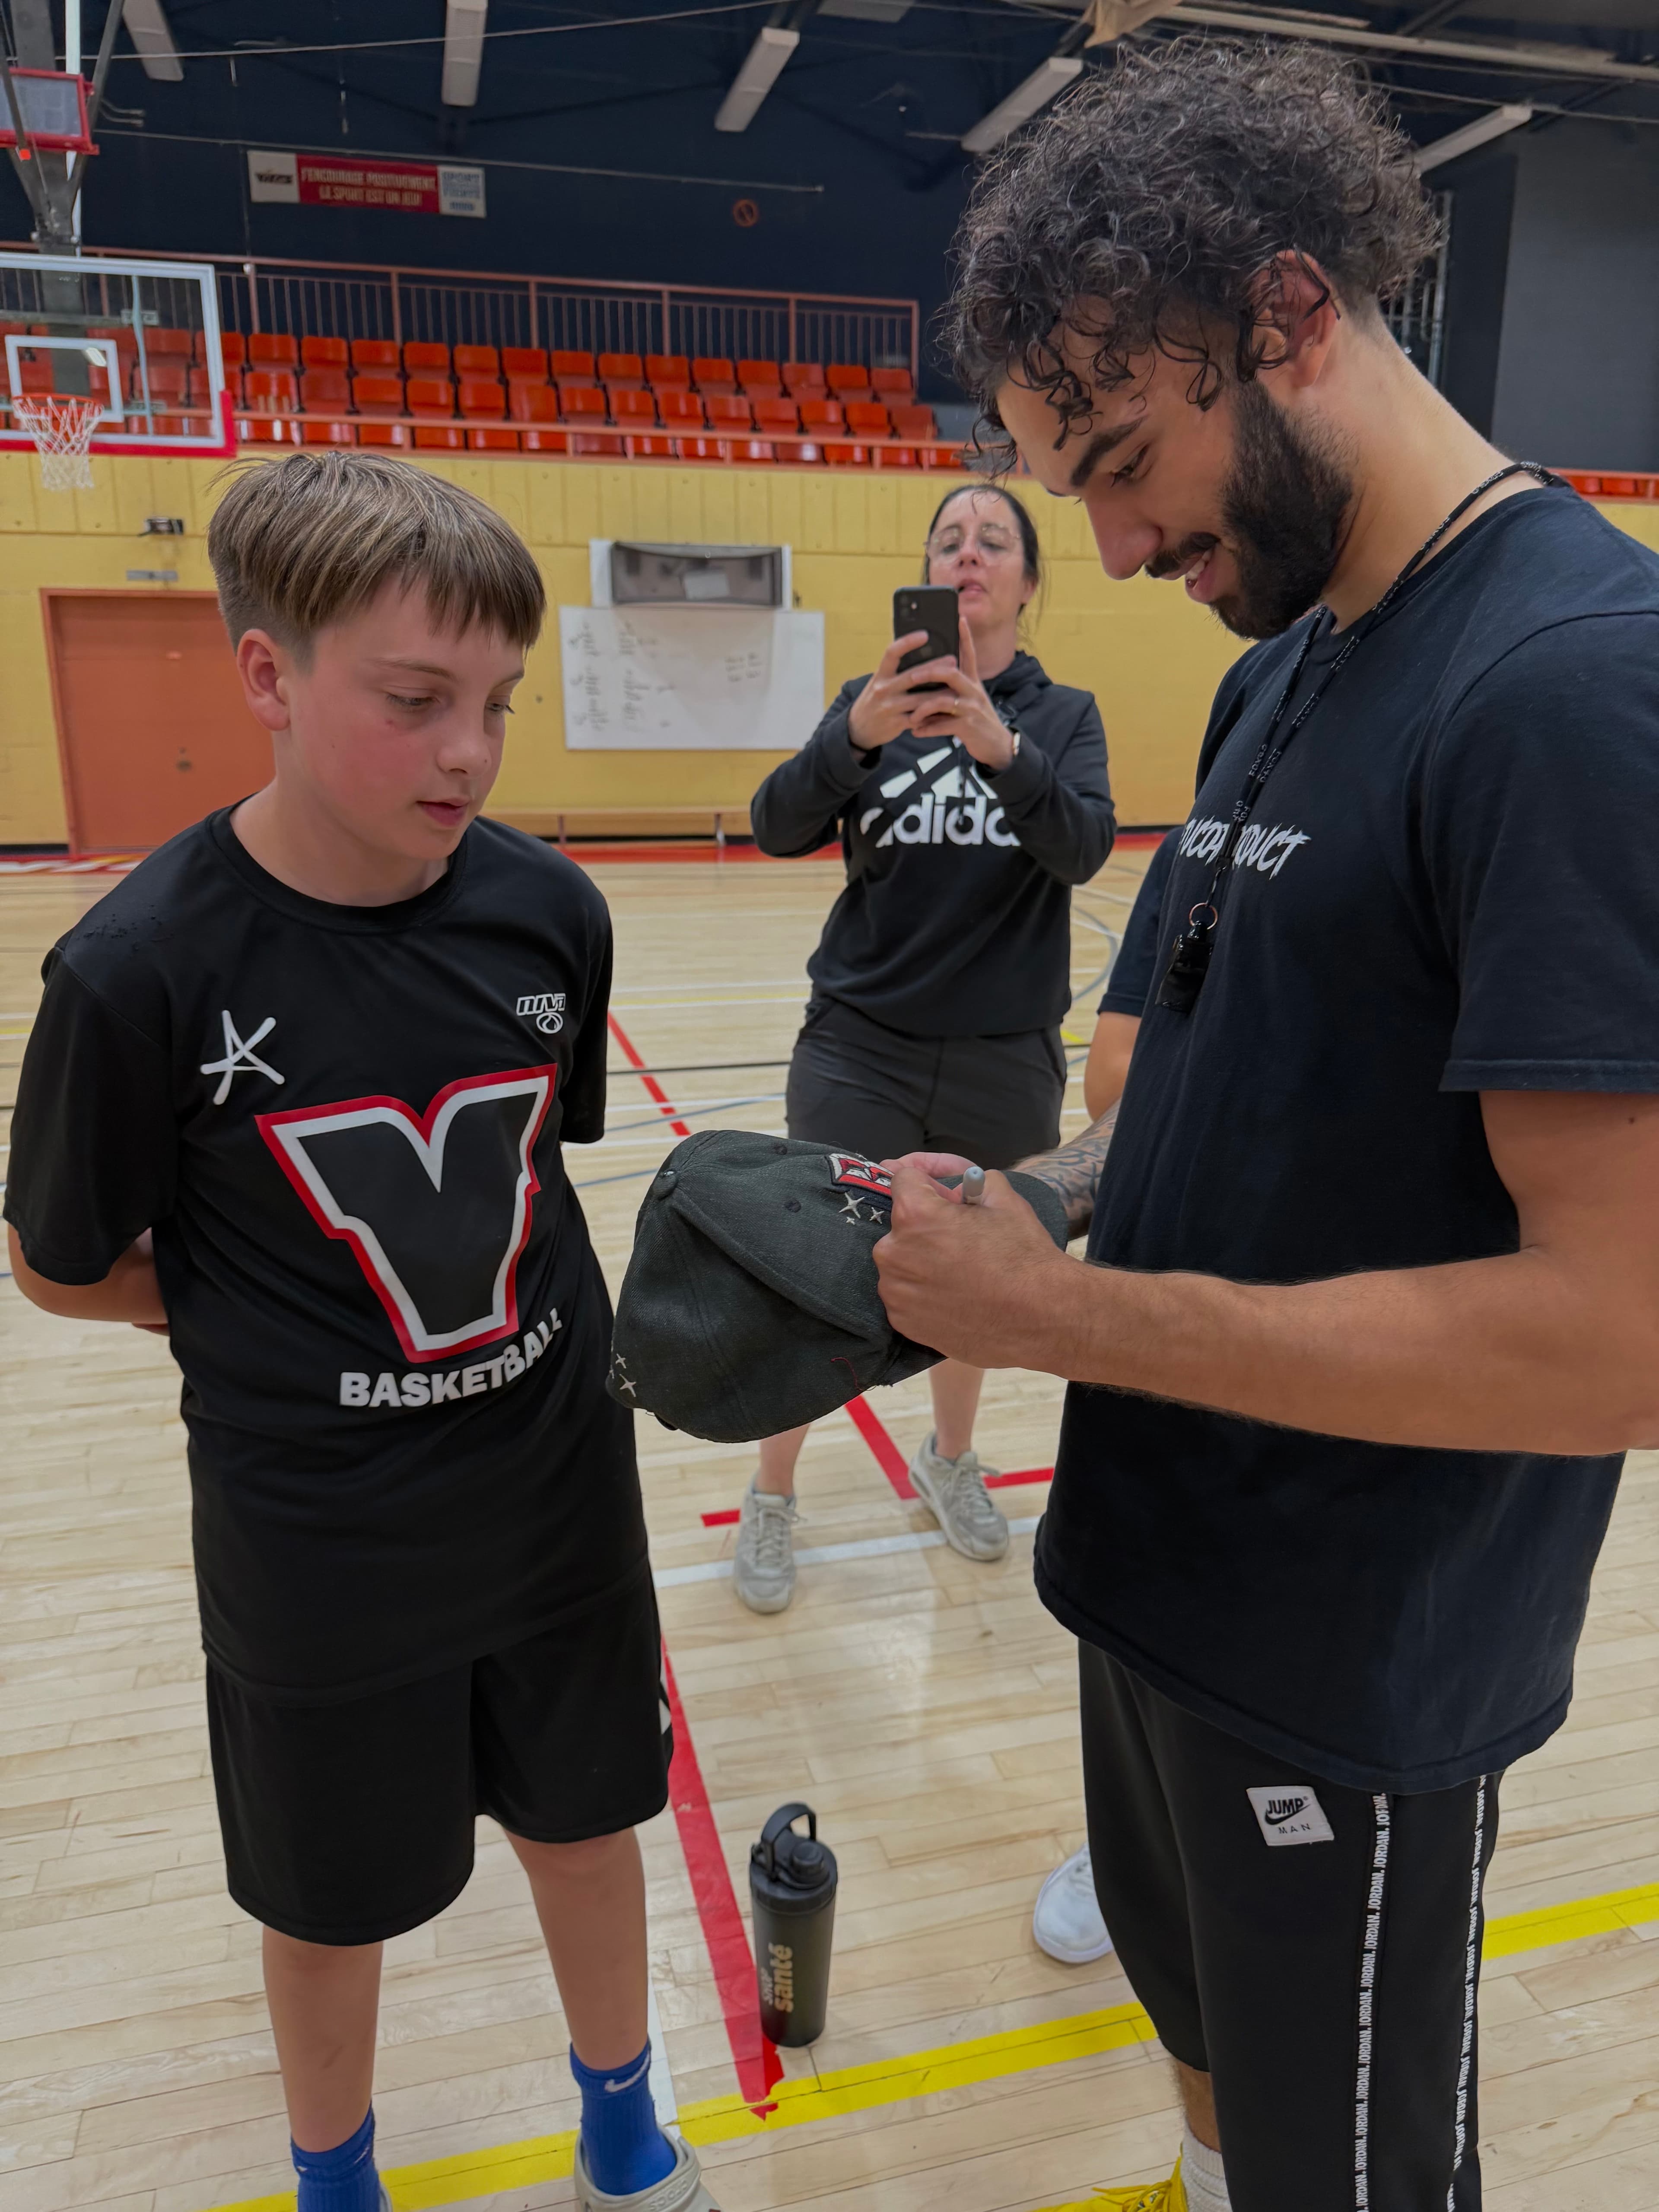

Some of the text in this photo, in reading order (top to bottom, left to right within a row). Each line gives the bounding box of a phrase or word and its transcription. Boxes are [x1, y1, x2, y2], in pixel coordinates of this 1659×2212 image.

[339, 1308, 563, 1408] BASKETBALL
[1266, 1798, 1304, 1815] JUMP
[1278, 1823, 1312, 1834] MAN
[768, 1942, 794, 2012] santé
